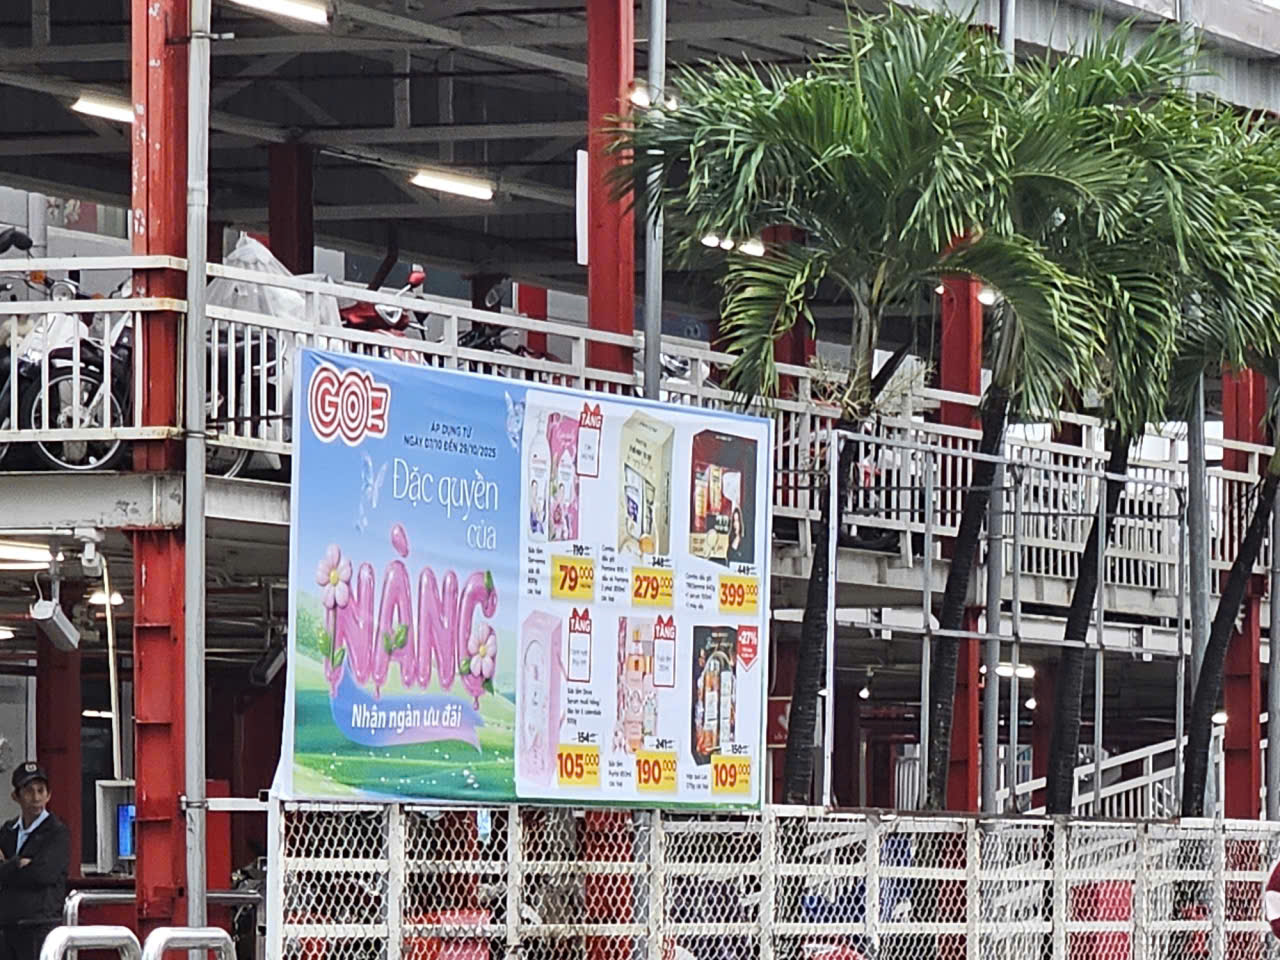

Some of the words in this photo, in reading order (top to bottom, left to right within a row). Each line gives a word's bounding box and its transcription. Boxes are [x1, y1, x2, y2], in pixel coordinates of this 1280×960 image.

[393, 458, 433, 507] Đặc
[438, 469, 498, 520] quyền
[467, 520, 496, 550] của
[352, 704, 386, 735] Nhận
[388, 704, 421, 733] ngàn
[424, 707, 439, 728] ưu
[442, 704, 462, 728] đãi
